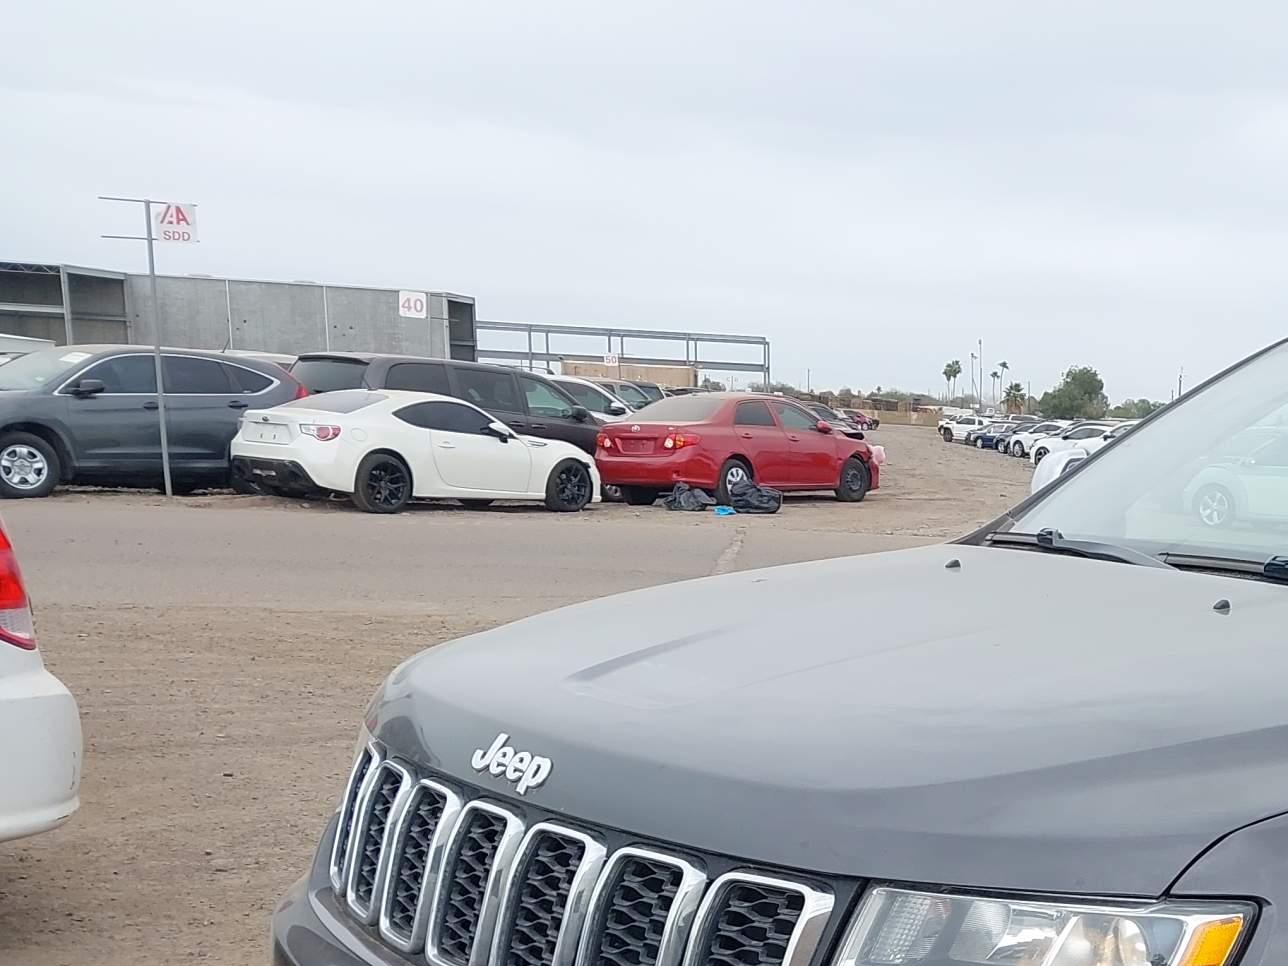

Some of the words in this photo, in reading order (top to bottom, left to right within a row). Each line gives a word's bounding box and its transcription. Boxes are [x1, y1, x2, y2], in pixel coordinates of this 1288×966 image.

[163, 230, 191, 241] SDD
[401, 297, 424, 313] 40
[606, 355, 617, 364] 50
[471, 732, 553, 796] Jeep
